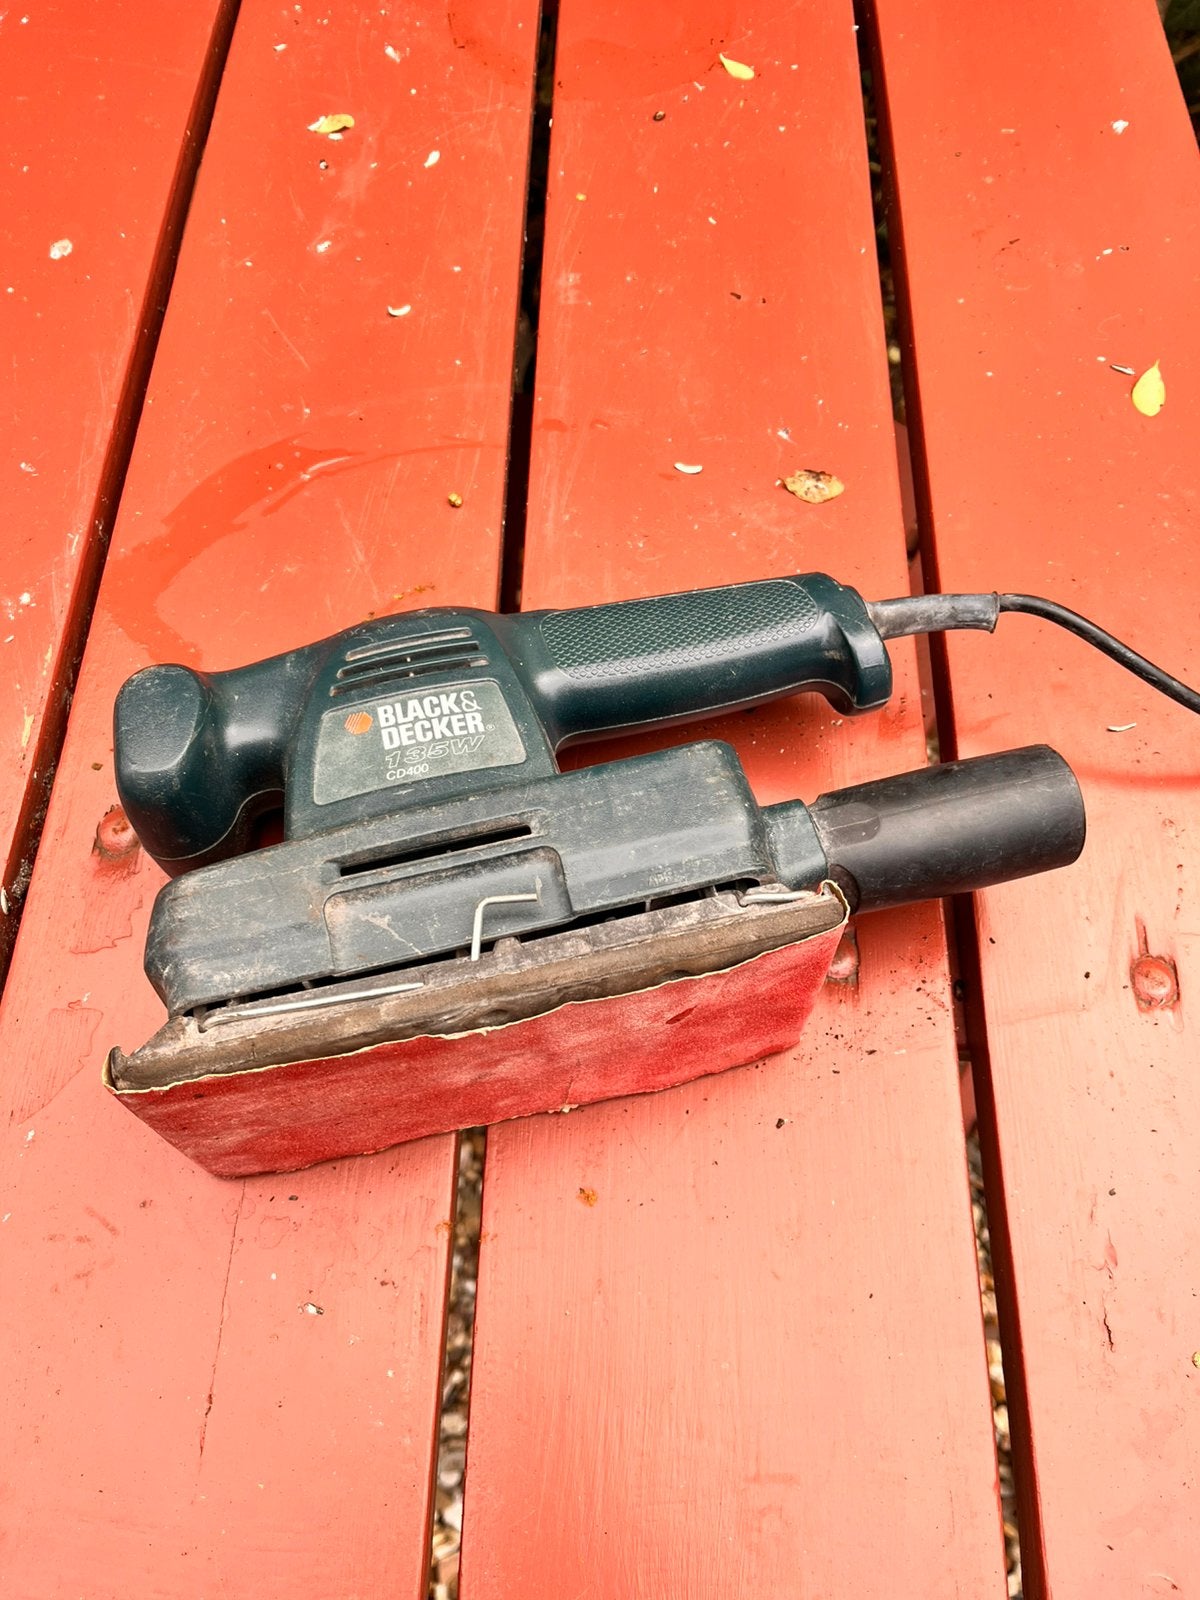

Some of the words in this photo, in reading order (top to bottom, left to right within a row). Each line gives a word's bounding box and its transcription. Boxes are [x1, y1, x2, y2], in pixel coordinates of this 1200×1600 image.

[380, 712, 486, 750] DECKER
[385, 735, 485, 769] 135W
[386, 763, 429, 781] CD400
